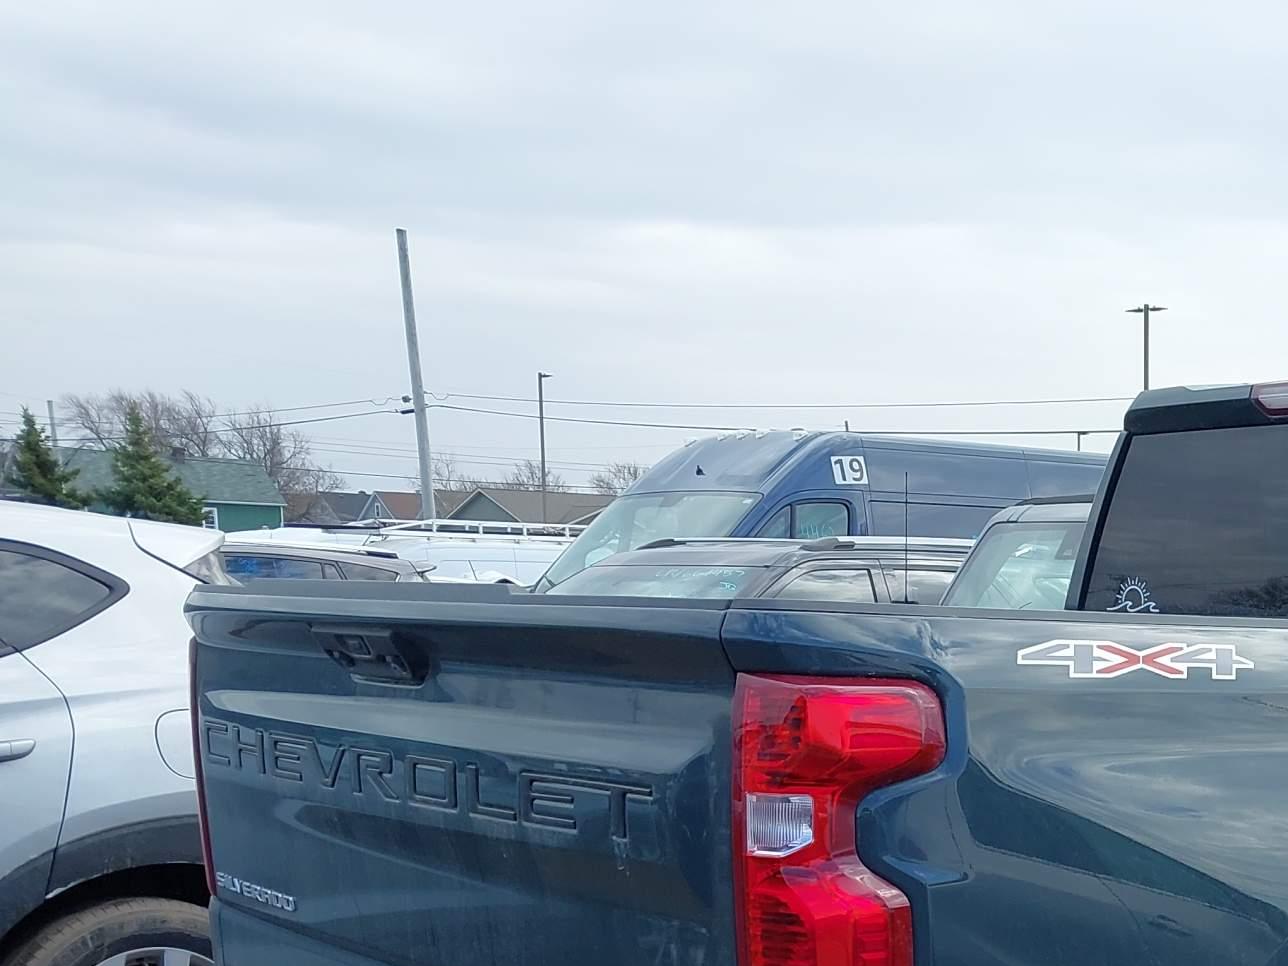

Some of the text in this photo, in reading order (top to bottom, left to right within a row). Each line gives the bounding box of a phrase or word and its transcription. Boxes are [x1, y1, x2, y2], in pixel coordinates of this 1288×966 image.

[834, 458, 864, 481] 19
[204, 720, 654, 842] CHEVROLET
[216, 871, 297, 912] SILVERADO
